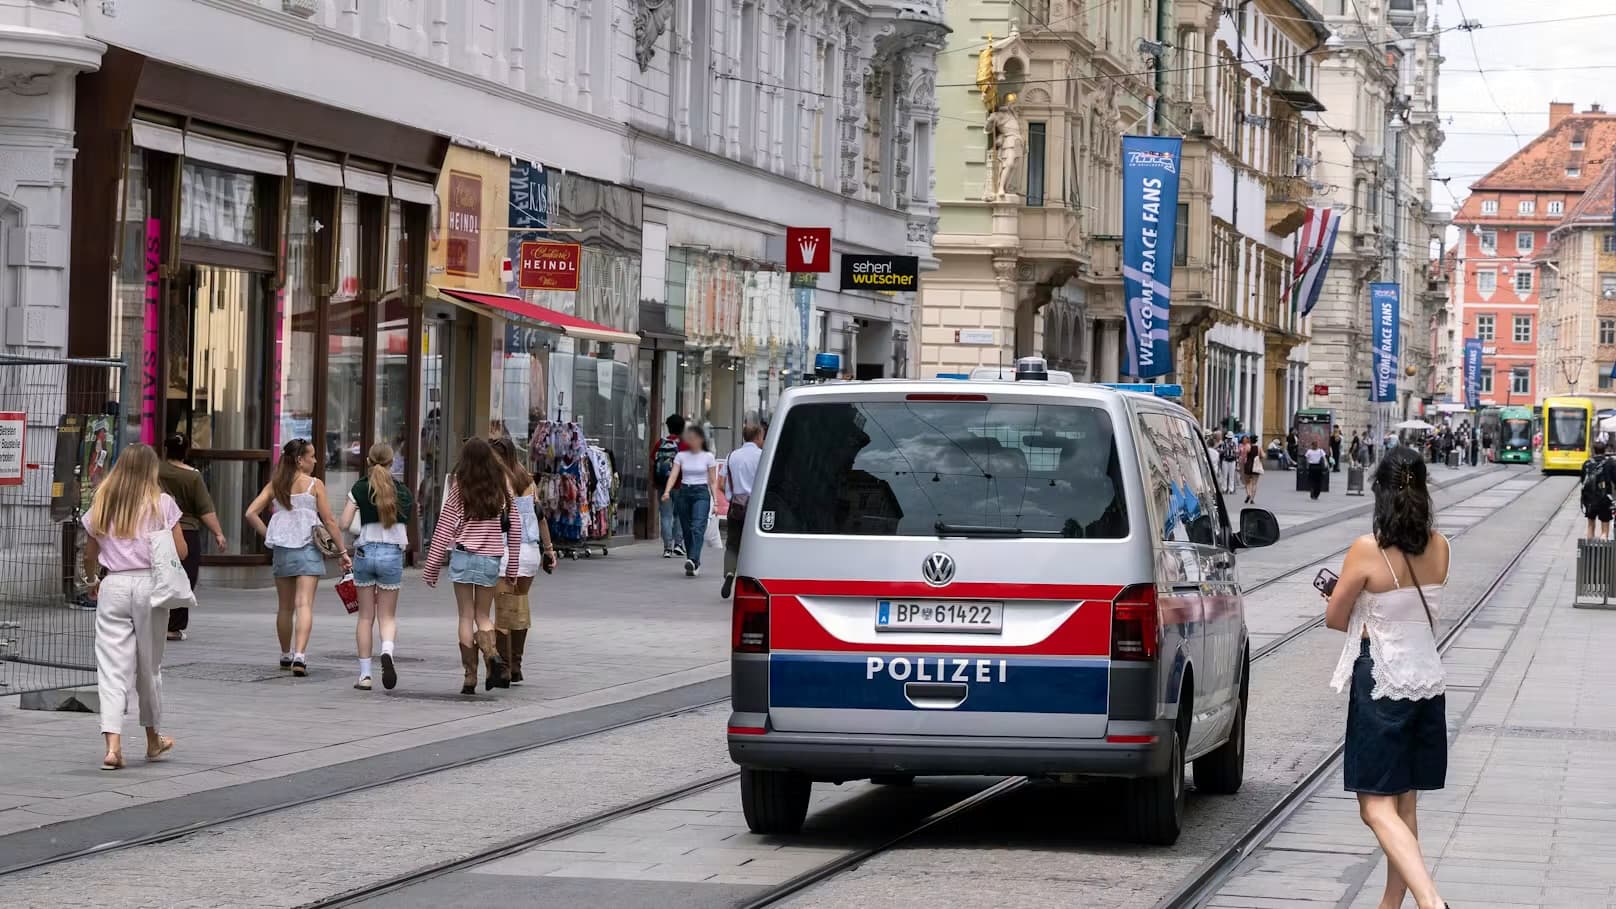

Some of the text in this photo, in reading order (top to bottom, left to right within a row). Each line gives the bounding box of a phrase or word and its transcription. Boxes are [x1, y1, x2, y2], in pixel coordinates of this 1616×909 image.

[1142, 177, 1162, 223] FANS
[449, 211, 480, 234] HEINDL
[1142, 228, 1158, 275] RACE
[523, 259, 575, 271] HEINDL
[852, 260, 892, 273] sehen!
[852, 272, 914, 285] wutscher
[1139, 279, 1154, 366] WELCOME
[1381, 303, 1393, 326] FANS
[1381, 327, 1393, 352] RACE
[1378, 354, 1392, 397] WELCOME
[896, 604, 920, 623] BP
[935, 605, 992, 624] 61422
[866, 656, 1007, 683] POLIZEI
